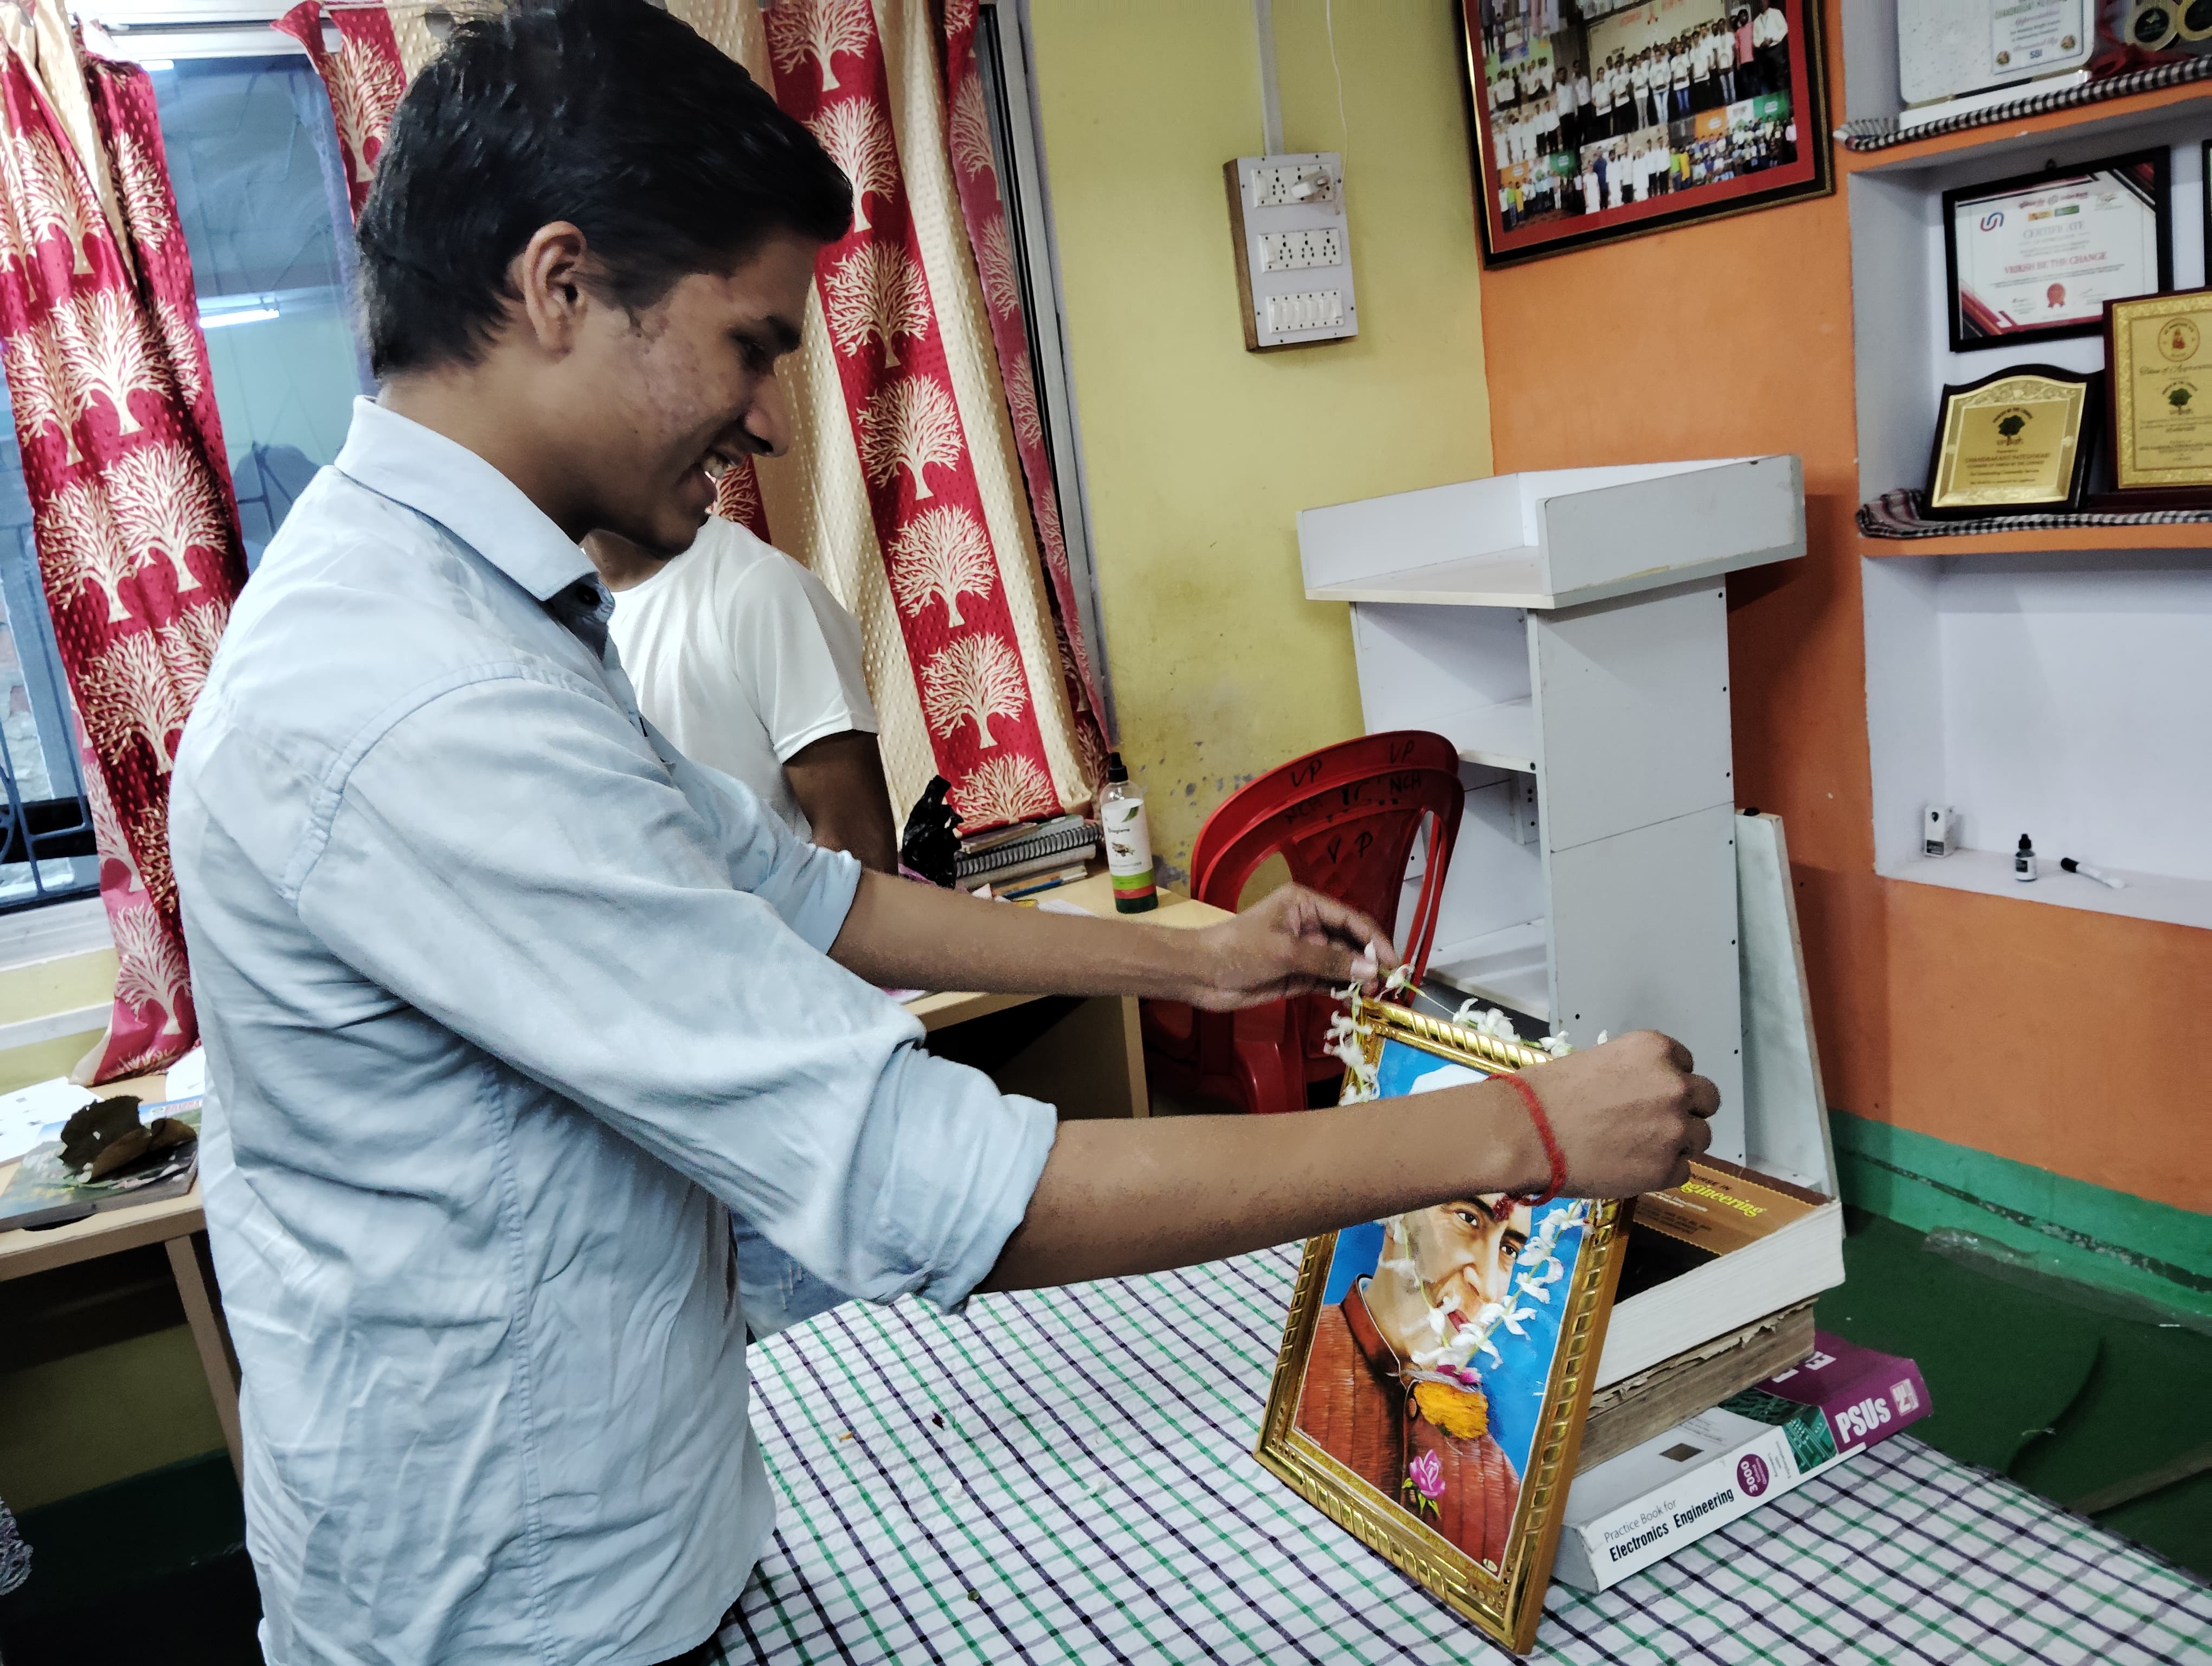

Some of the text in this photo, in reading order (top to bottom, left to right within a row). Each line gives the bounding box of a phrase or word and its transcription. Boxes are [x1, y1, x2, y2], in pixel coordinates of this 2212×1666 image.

[1681, 1181, 1767, 1218] gineering
[1834, 1398, 1892, 1444] PSUs
[1740, 1460, 1758, 1493] 3000
[1604, 1498, 1677, 1543] Practice Book for
[1609, 1489, 1735, 1562] Electronics Engineering
